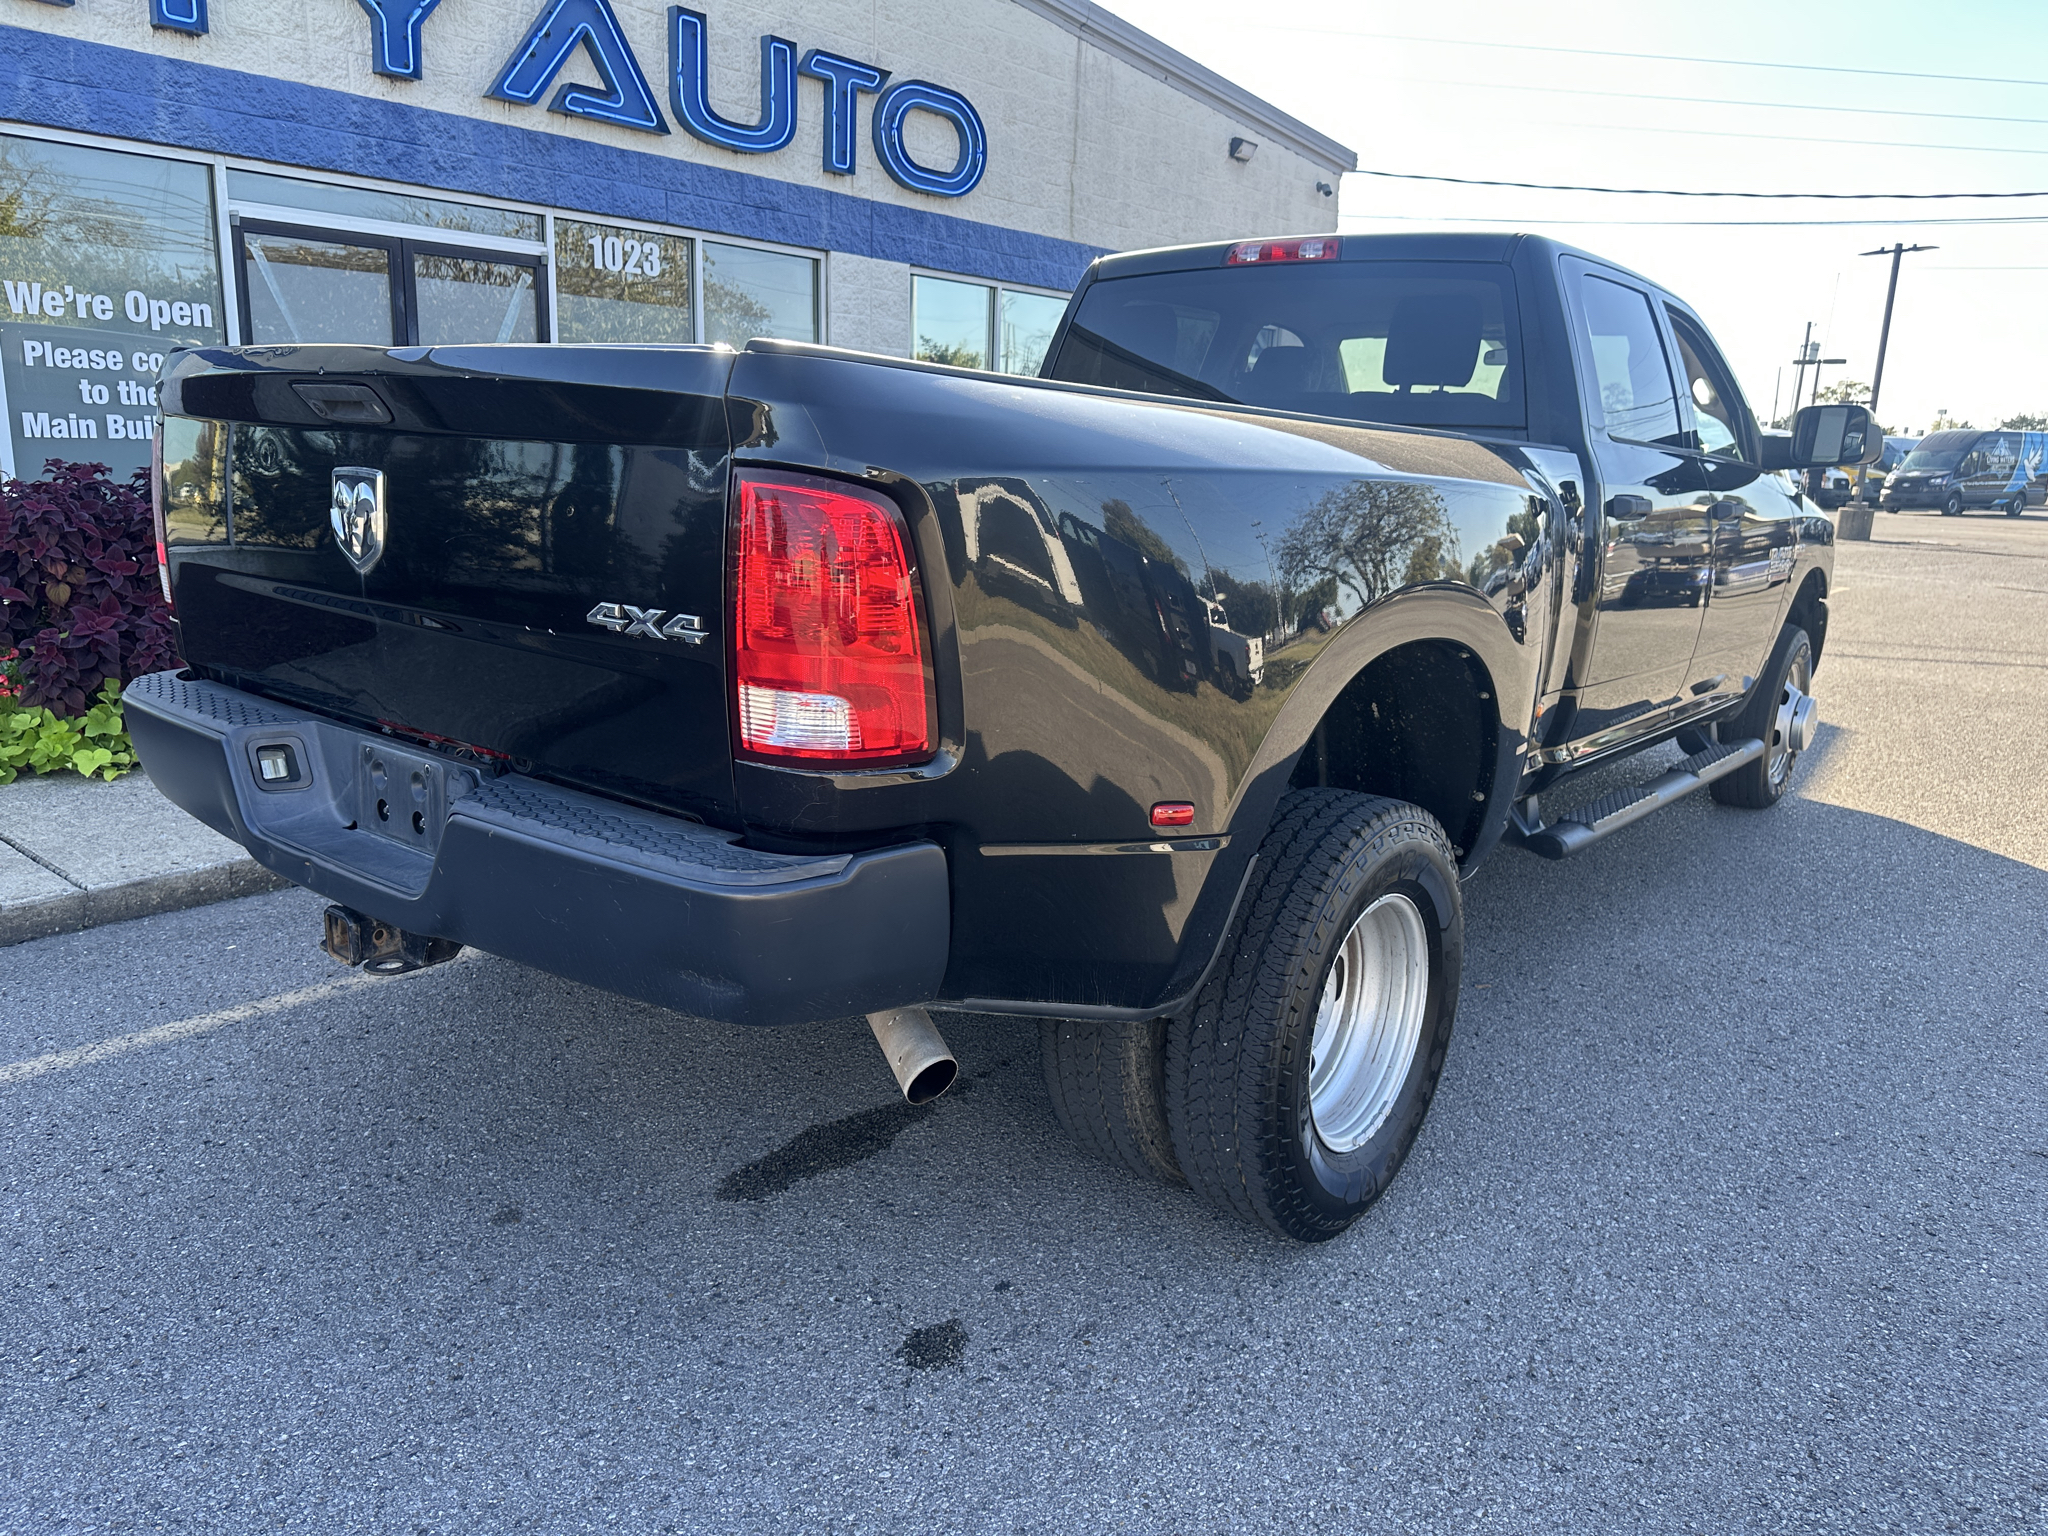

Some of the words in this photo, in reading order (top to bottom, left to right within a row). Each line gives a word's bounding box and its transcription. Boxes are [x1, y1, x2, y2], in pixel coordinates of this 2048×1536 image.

[588, 235, 660, 277] 1023
[3, 280, 114, 321] We're
[125, 290, 213, 331] Open
[23, 340, 123, 370] Please
[132, 352, 164, 372] co
[79, 379, 109, 404] to
[22, 412, 97, 439] Main
[106, 414, 155, 440] Bui
[586, 602, 710, 645] 4X4
